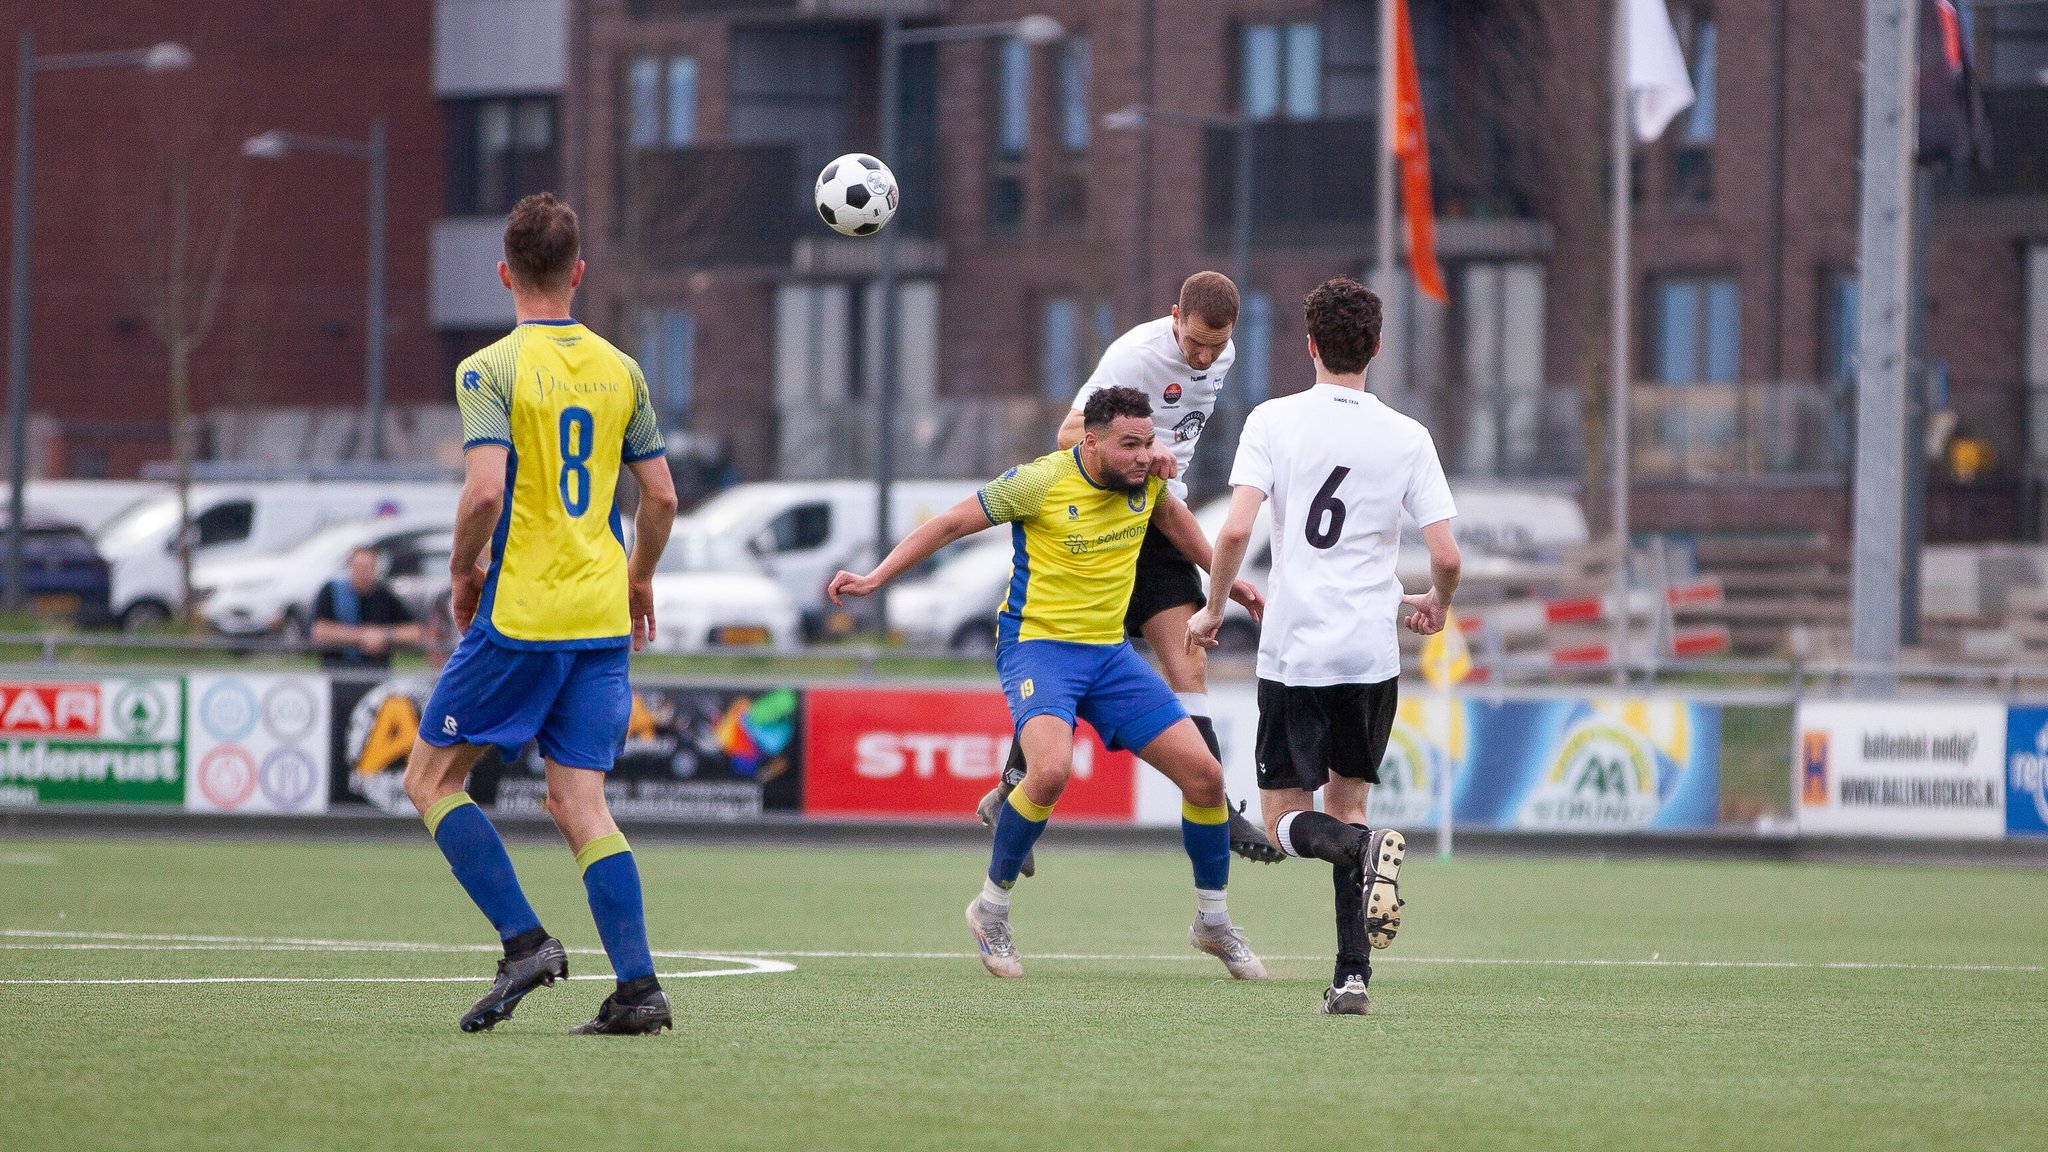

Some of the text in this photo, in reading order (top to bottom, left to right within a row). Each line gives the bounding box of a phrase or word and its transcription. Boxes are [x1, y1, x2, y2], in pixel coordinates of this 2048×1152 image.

[559, 406, 595, 518] 8
[1304, 465, 1352, 550] 6
[1096, 524, 1147, 545] solutions
[0, 688, 97, 732] AR
[1021, 678, 1035, 700] 19
[856, 730, 1094, 778] STE
